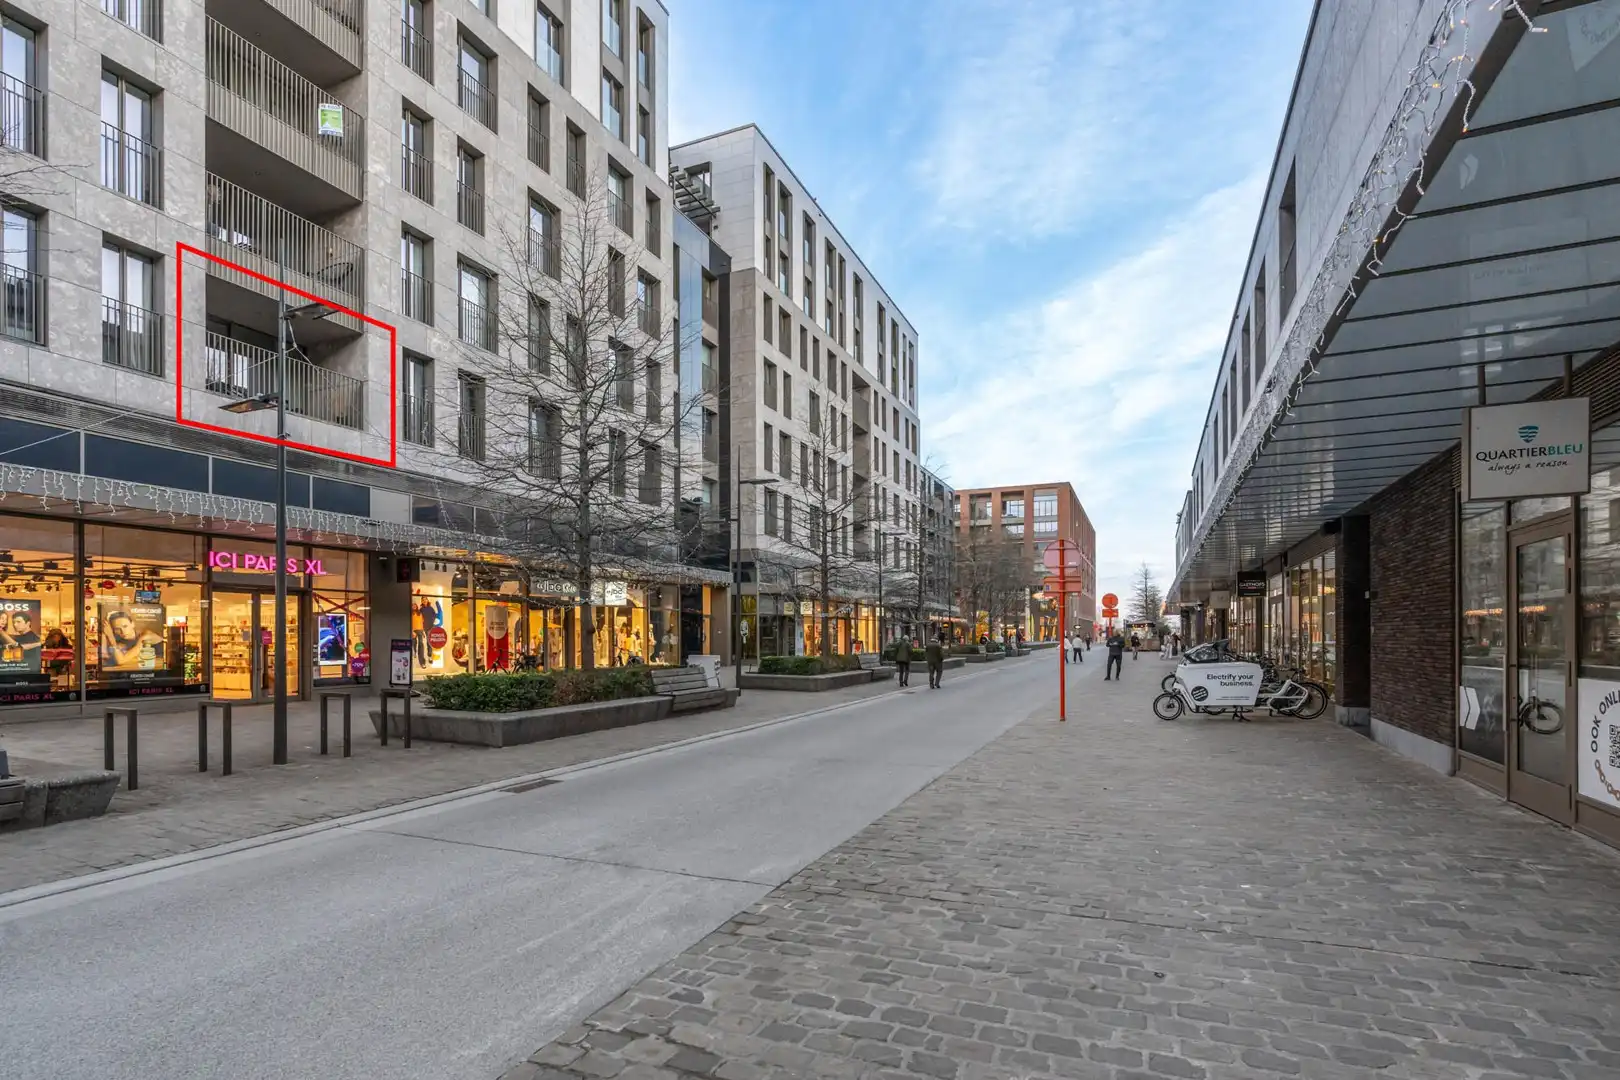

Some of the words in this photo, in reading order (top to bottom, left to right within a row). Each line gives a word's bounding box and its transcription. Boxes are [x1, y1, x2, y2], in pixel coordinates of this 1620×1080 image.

[1476, 444, 1583, 462] QUARTIERBLEU
[1488, 463, 1520, 475] always
[1536, 460, 1568, 468] reason
[208, 551, 237, 569] ICI
[244, 554, 298, 573] PARS
[305, 560, 327, 575] XL
[1207, 673, 1237, 681] Electrify
